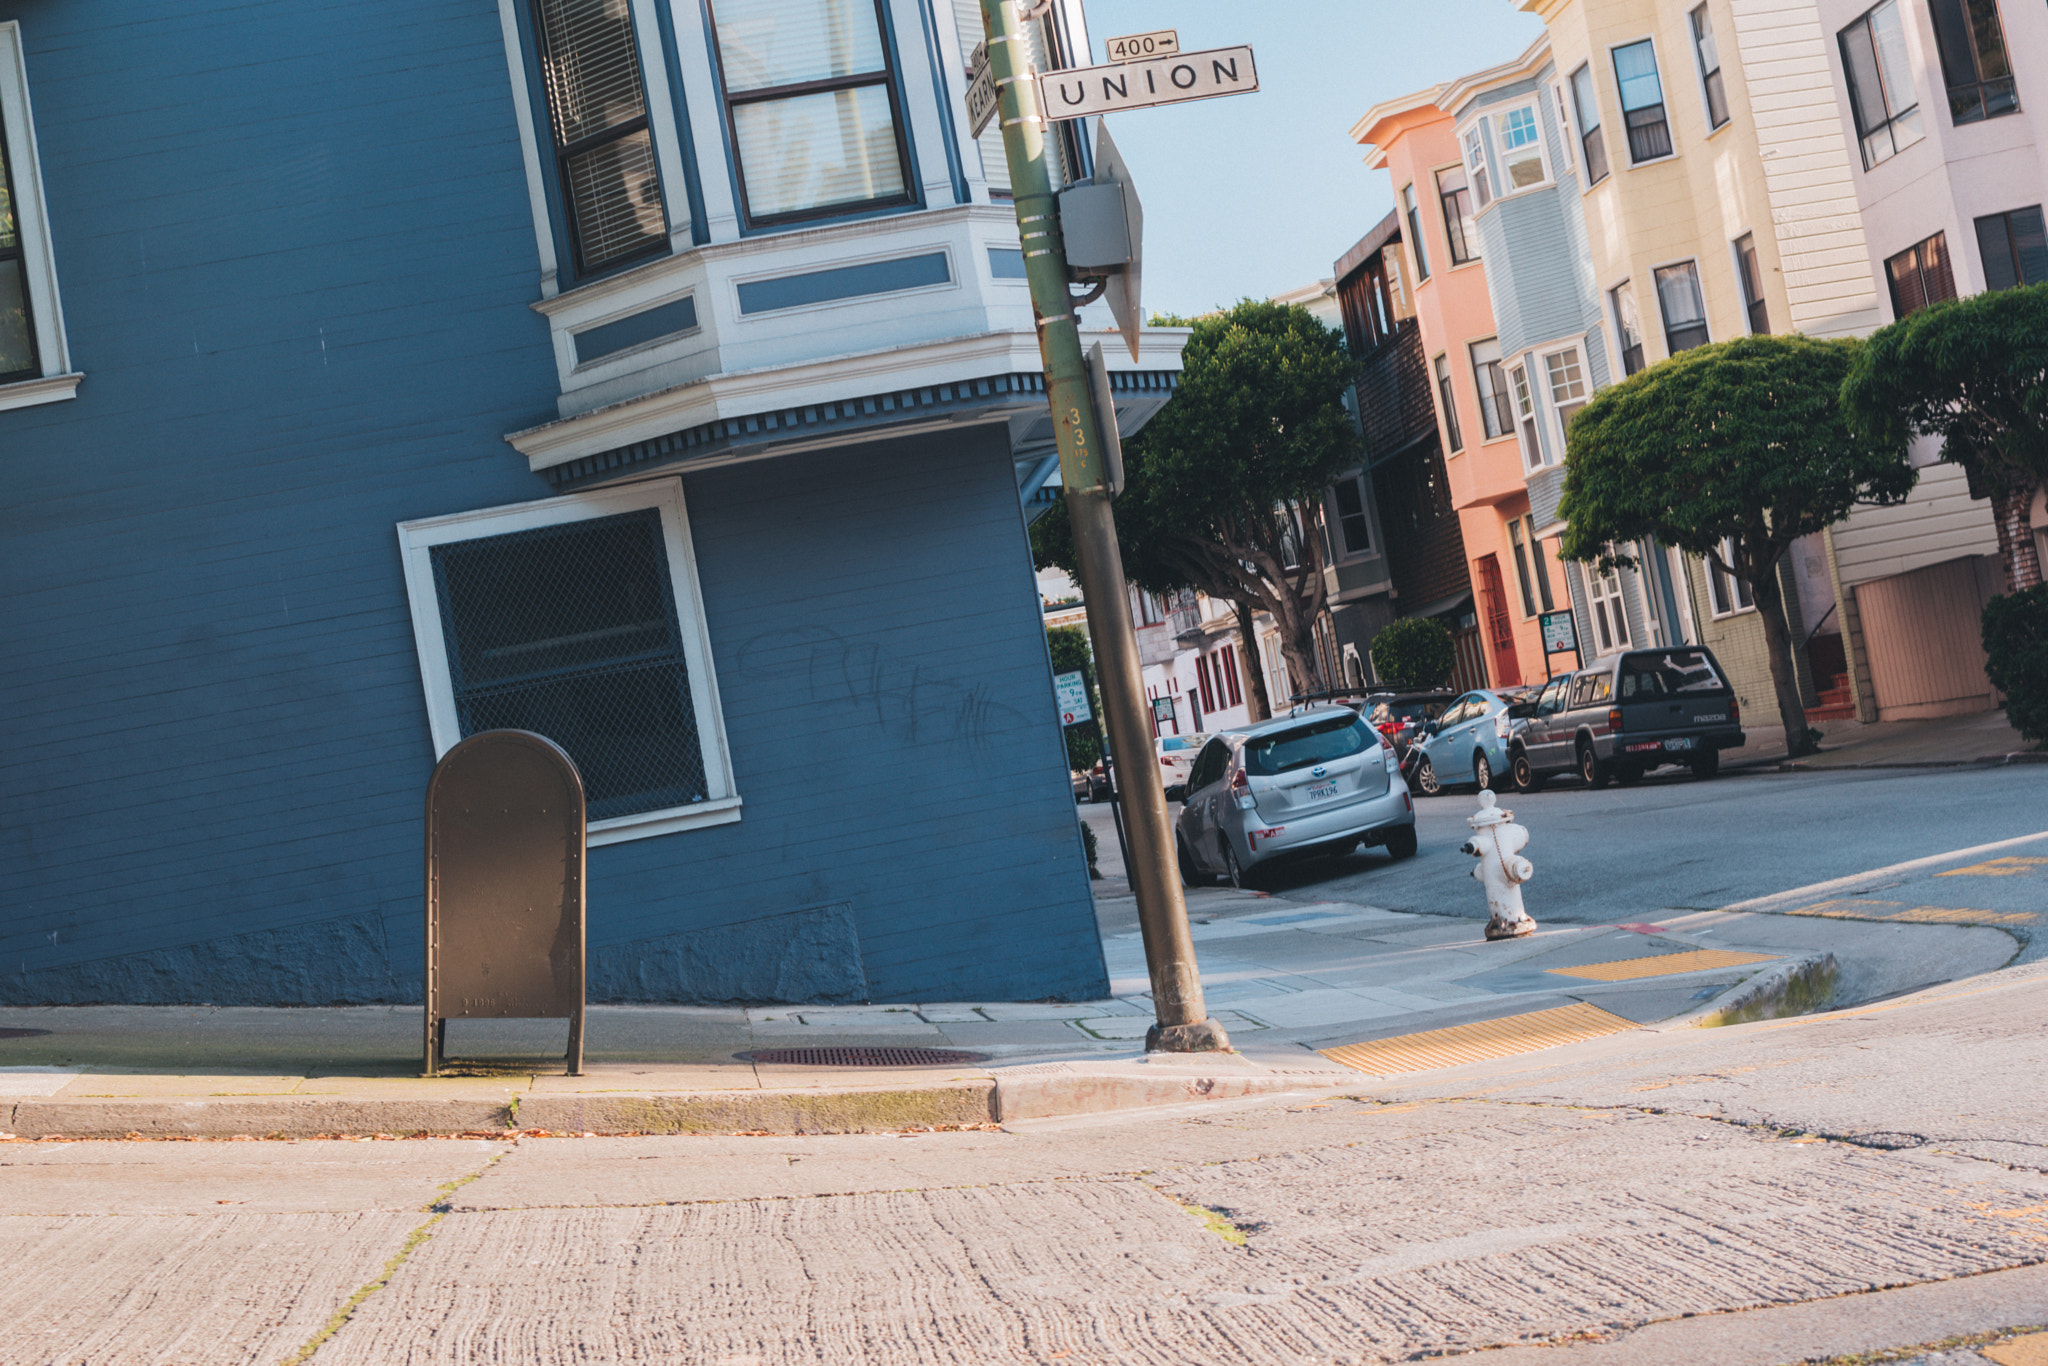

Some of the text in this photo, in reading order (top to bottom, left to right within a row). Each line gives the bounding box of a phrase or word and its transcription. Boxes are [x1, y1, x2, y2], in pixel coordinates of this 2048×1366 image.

[1114, 37, 1155, 57] 400
[1060, 58, 1239, 105] UNION
[1544, 617, 1549, 625] 2
[1059, 673, 1075, 682] HOUR
[1056, 679, 1082, 690] PARKING
[1069, 688, 1075, 697] 9
[1309, 786, 1338, 800] 7PRK196
